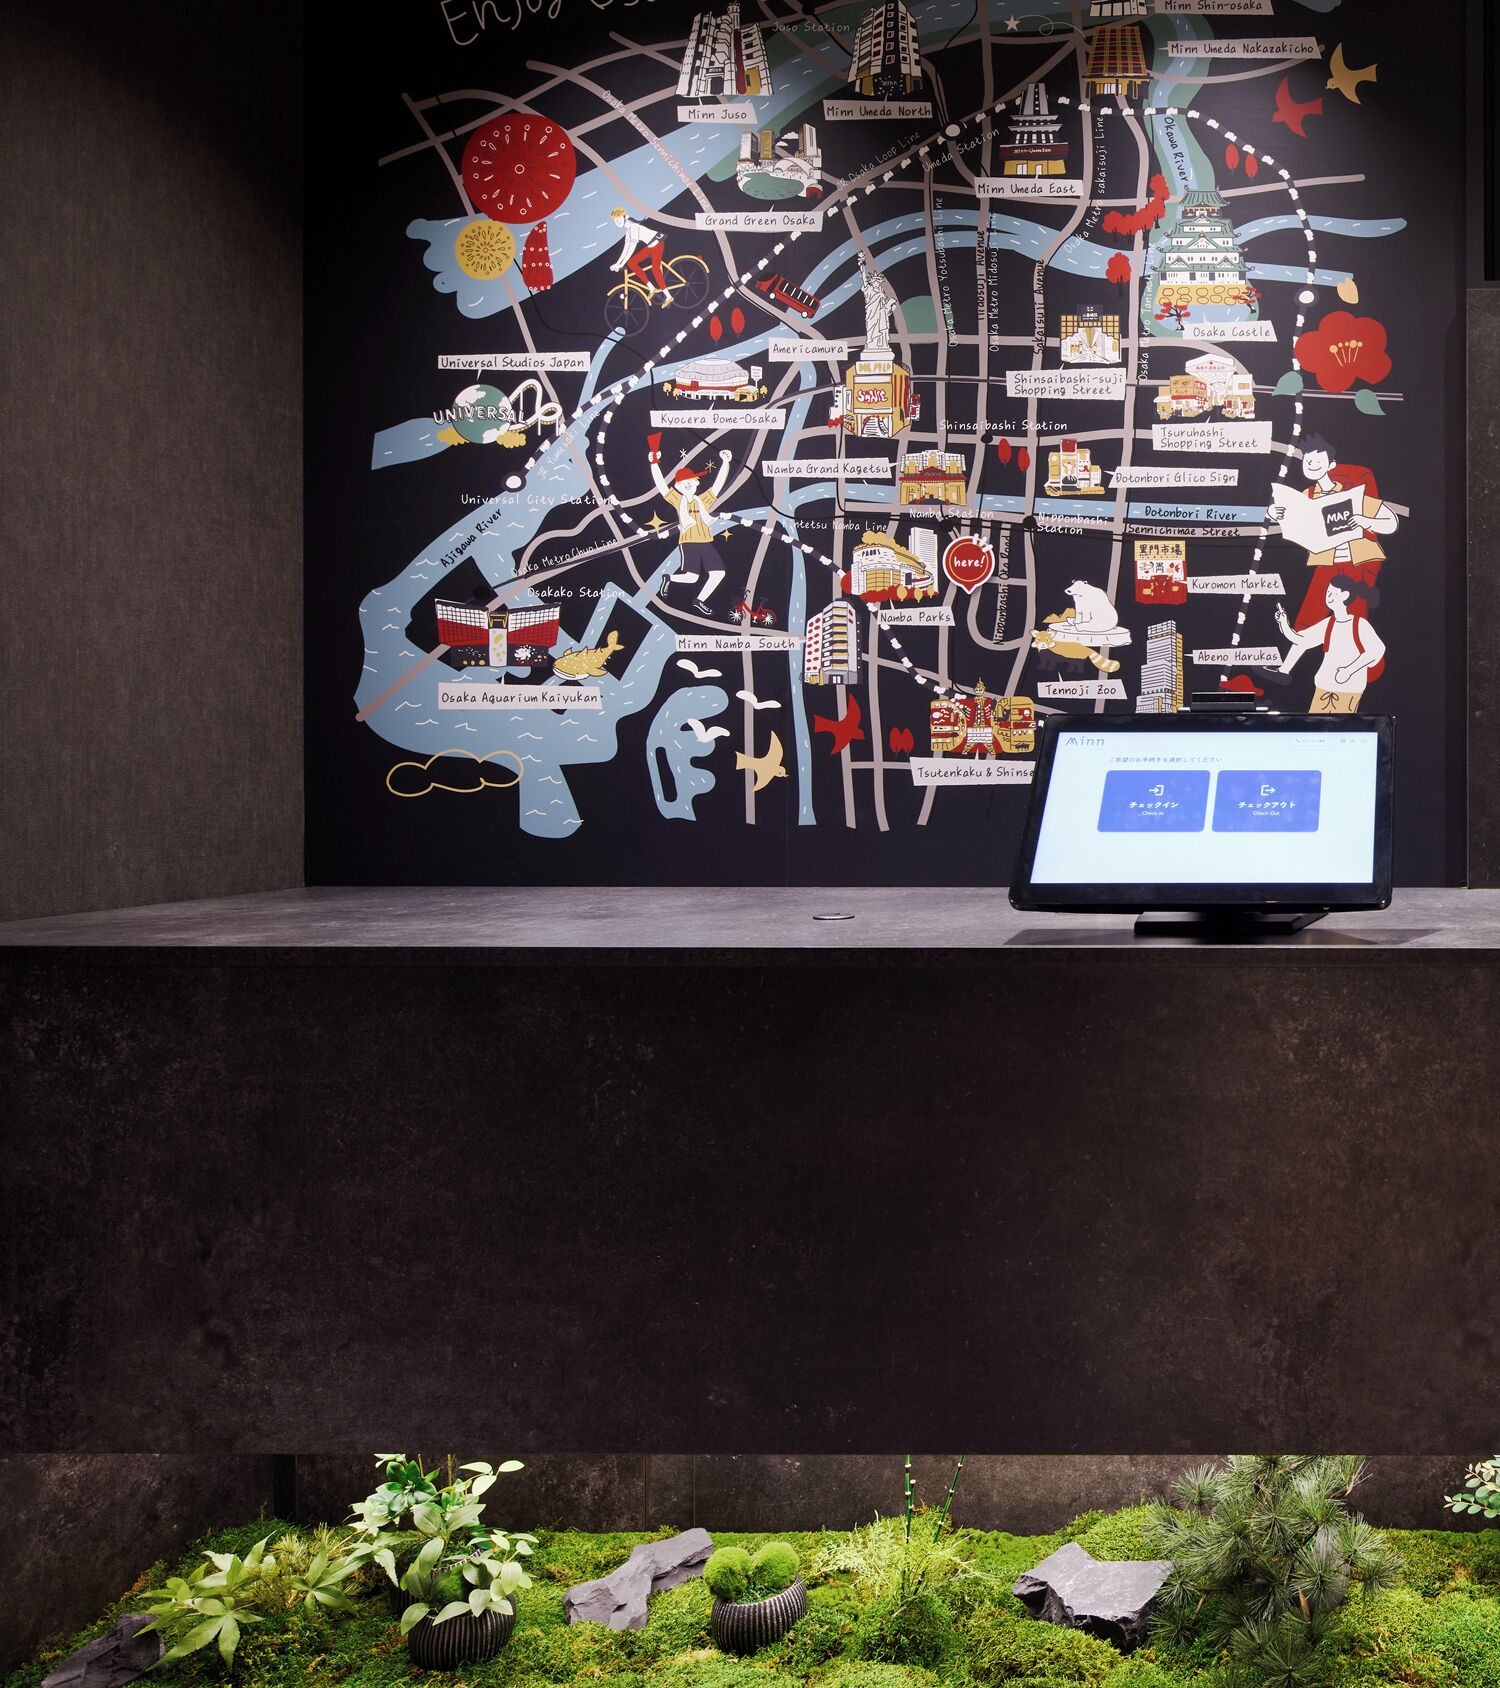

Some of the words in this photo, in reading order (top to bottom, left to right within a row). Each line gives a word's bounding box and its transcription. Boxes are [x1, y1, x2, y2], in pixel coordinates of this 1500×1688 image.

[1164, 1, 1192, 11] Minn
[1197, 1, 1263, 11] Shin-osaka
[772, 21, 798, 33] Juso
[804, 21, 850, 33] Station
[1171, 44, 1198, 54] Minn
[1203, 43, 1237, 54] Umeda
[1242, 43, 1314, 54] Nakazakicho
[602, 89, 627, 114] Osaka
[687, 109, 715, 120] Minn
[720, 109, 747, 120] Juso
[827, 106, 854, 117] Minn
[859, 106, 892, 116] Umeda
[899, 105, 932, 116] North
[1094, 117, 1104, 139] Line
[922, 152, 954, 173] Umeda
[956, 129, 1000, 155] Station
[1163, 116, 1178, 150] Okawa
[1173, 152, 1188, 183] River
[849, 162, 875, 185] Osaka
[878, 145, 897, 165] Loop
[900, 131, 921, 151] Line
[978, 184, 1005, 195] Minn
[1010, 183, 1043, 195] Umeda
[1049, 183, 1076, 194] East
[932, 197, 943, 220] Line
[1085, 200, 1104, 228] Metro
[705, 215, 738, 226] Grand
[744, 215, 777, 226] Green
[782, 215, 816, 226] Osaka
[1064, 230, 1090, 254] Osaka
[987, 242, 999, 286] Midosuji
[940, 285, 952, 315] Metro
[988, 290, 999, 319] Metro
[944, 318, 958, 347] Osaka
[988, 323, 999, 352] Osaka
[1192, 327, 1226, 338] Osaka
[1231, 326, 1271, 338] Castle
[772, 344, 844, 355] Americamura
[441, 356, 498, 368] Universal
[502, 356, 546, 367] Studios
[549, 356, 585, 370] Japan
[1138, 352, 1149, 380] Osaka
[1014, 373, 1123, 386] Shinsaibashi-suji
[1014, 385, 1066, 397] Shopping
[1072, 385, 1112, 395] Street
[433, 405, 528, 426] UNIVERSAL
[661, 414, 706, 427] Kyocera
[939, 419, 1016, 431] Shinsaibashi
[1021, 419, 1068, 431] Station
[1160, 427, 1224, 438] Tsuruhashi
[1160, 438, 1212, 450] Shopping
[1218, 438, 1258, 449] Street
[766, 464, 804, 475] Namba
[806, 463, 839, 475] Grand
[843, 462, 889, 477] Kagetsu
[1173, 472, 1206, 483] Glico
[1210, 473, 1236, 485] Sign
[461, 494, 519, 505] Universal
[527, 494, 554, 509] City
[560, 494, 615, 505] Station
[909, 508, 943, 519] Namba
[948, 508, 994, 519] Station
[1038, 512, 1109, 526] Nipponbashi
[1206, 509, 1238, 521] River
[1326, 511, 1350, 524] MAP
[865, 521, 888, 532] Line
[1037, 523, 1083, 535] Station
[1202, 526, 1241, 538] Street
[440, 535, 477, 568] Ajigawa
[475, 508, 503, 536] River
[542, 553, 571, 568] Metro
[953, 556, 986, 569] here!
[1192, 579, 1236, 590] Kuromon
[1241, 579, 1280, 589] Market
[527, 587, 573, 599] Osakako
[579, 587, 625, 598] Station
[880, 611, 913, 623] Namba
[918, 610, 951, 622] Parks
[678, 639, 708, 650] Minn
[715, 639, 752, 649] Namba
[758, 638, 796, 649] South
[1197, 652, 1229, 662] Abeno
[1234, 651, 1278, 662] Harukas
[1045, 684, 1089, 697] Tennoji
[1097, 685, 1117, 696] Zoo
[441, 692, 477, 704] Osaka
[481, 692, 539, 705] Aquarium
[541, 692, 598, 705] Kaiyukan
[1065, 736, 1105, 747] Minn
[917, 767, 983, 778] Tsutenkaku
[986, 768, 993, 778] &
[1129, 800, 1179, 810] チェックイン
[1238, 800, 1296, 810] チェックアウト
